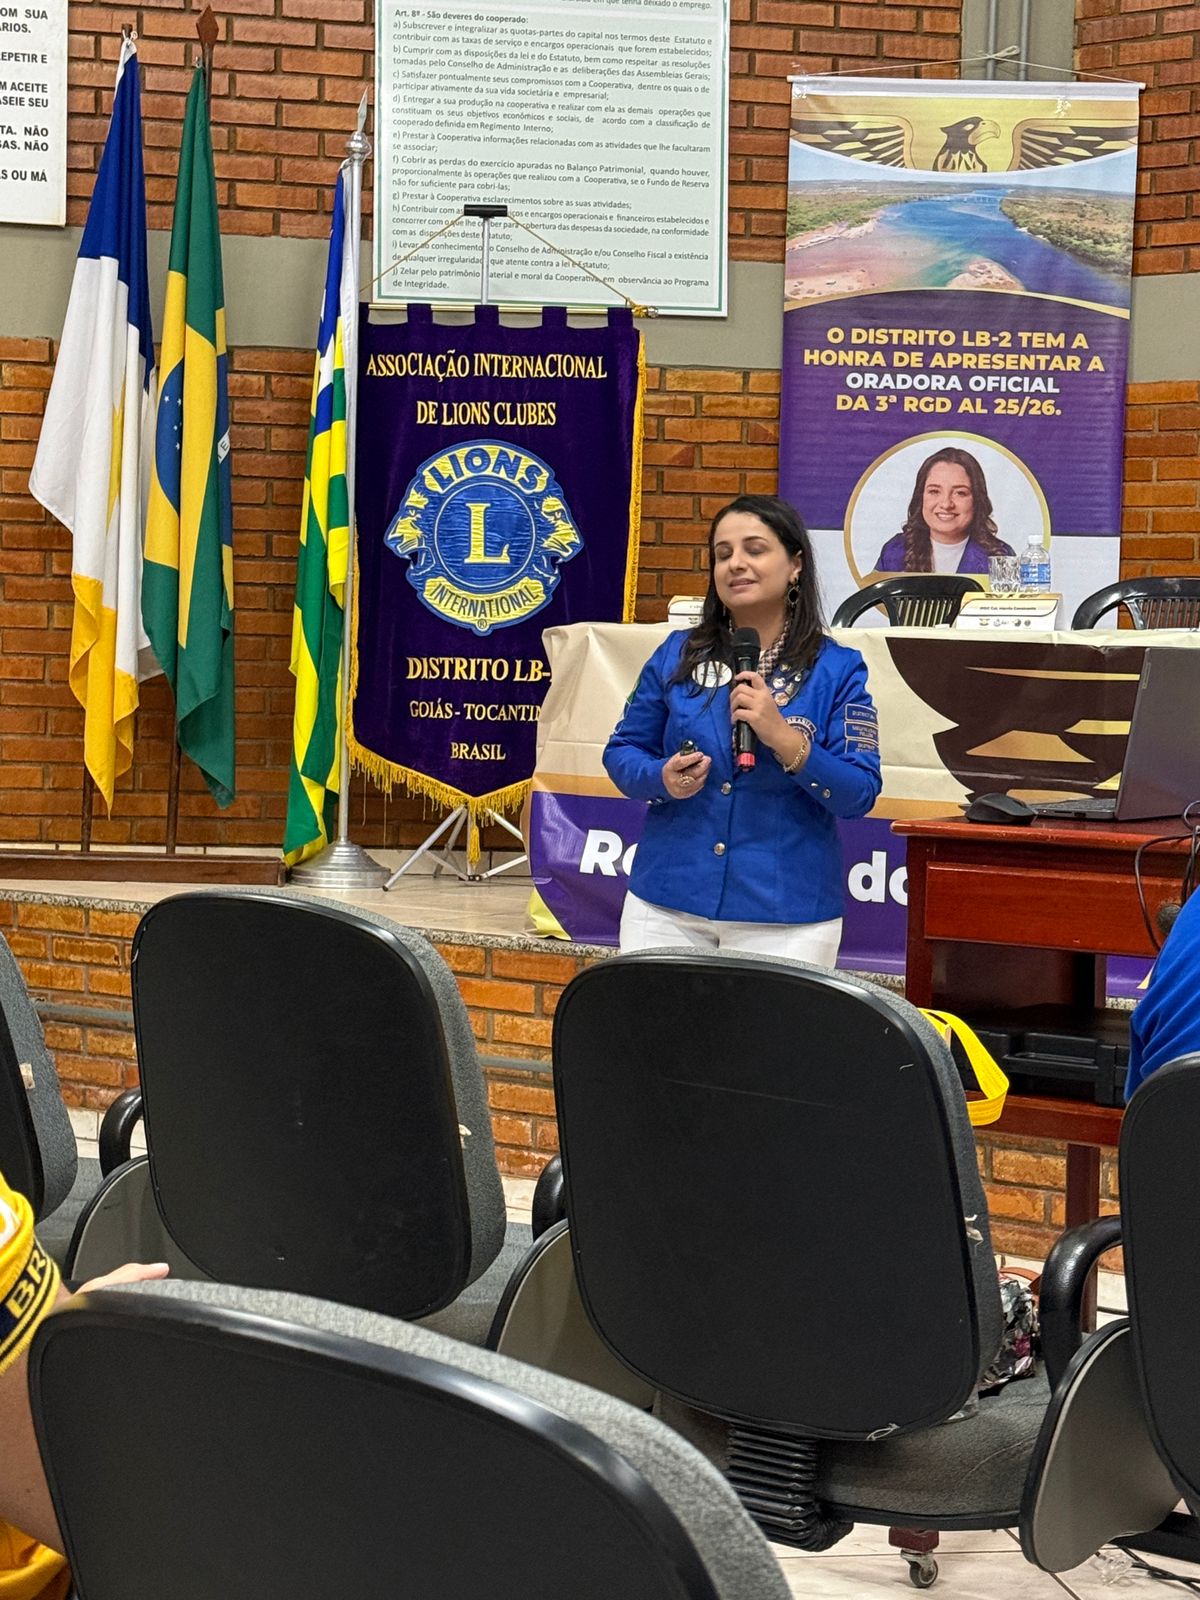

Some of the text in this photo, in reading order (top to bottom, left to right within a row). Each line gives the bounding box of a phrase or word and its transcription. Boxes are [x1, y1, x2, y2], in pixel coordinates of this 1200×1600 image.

[24, 9, 48, 20] SUA
[0, 22, 31, 33] RIOS.
[0, 51, 48, 64] EPETIR E
[10, 82, 48, 93] ACEITE
[0, 96, 48, 108] SEIE SEU
[24, 125, 48, 137] NÃO
[0, 140, 48, 152] AS. NÃO
[12, 170, 27, 180] OU
[31, 169, 47, 182] MÁ
[827, 327, 1089, 349] O DISTRITO LB-2 TEM A
[366, 349, 608, 382] ASSOCIAÇÃO INTERNACIONAL
[804, 349, 1104, 372] HONRA DE APRESENTAR A
[846, 372, 1060, 393] ORADORA OFICIAL
[416, 400, 556, 426] DE LIONS CLUBES
[836, 394, 1062, 416] DA 3ª RGD AL 25/26.
[428, 448, 543, 492] LIONS
[464, 503, 510, 564] L
[430, 583, 540, 618] INTERNATIONAL
[406, 657, 552, 682] DISTRITO LB-
[410, 698, 452, 719] GOIÁS
[450, 742, 506, 760] BRASIL
